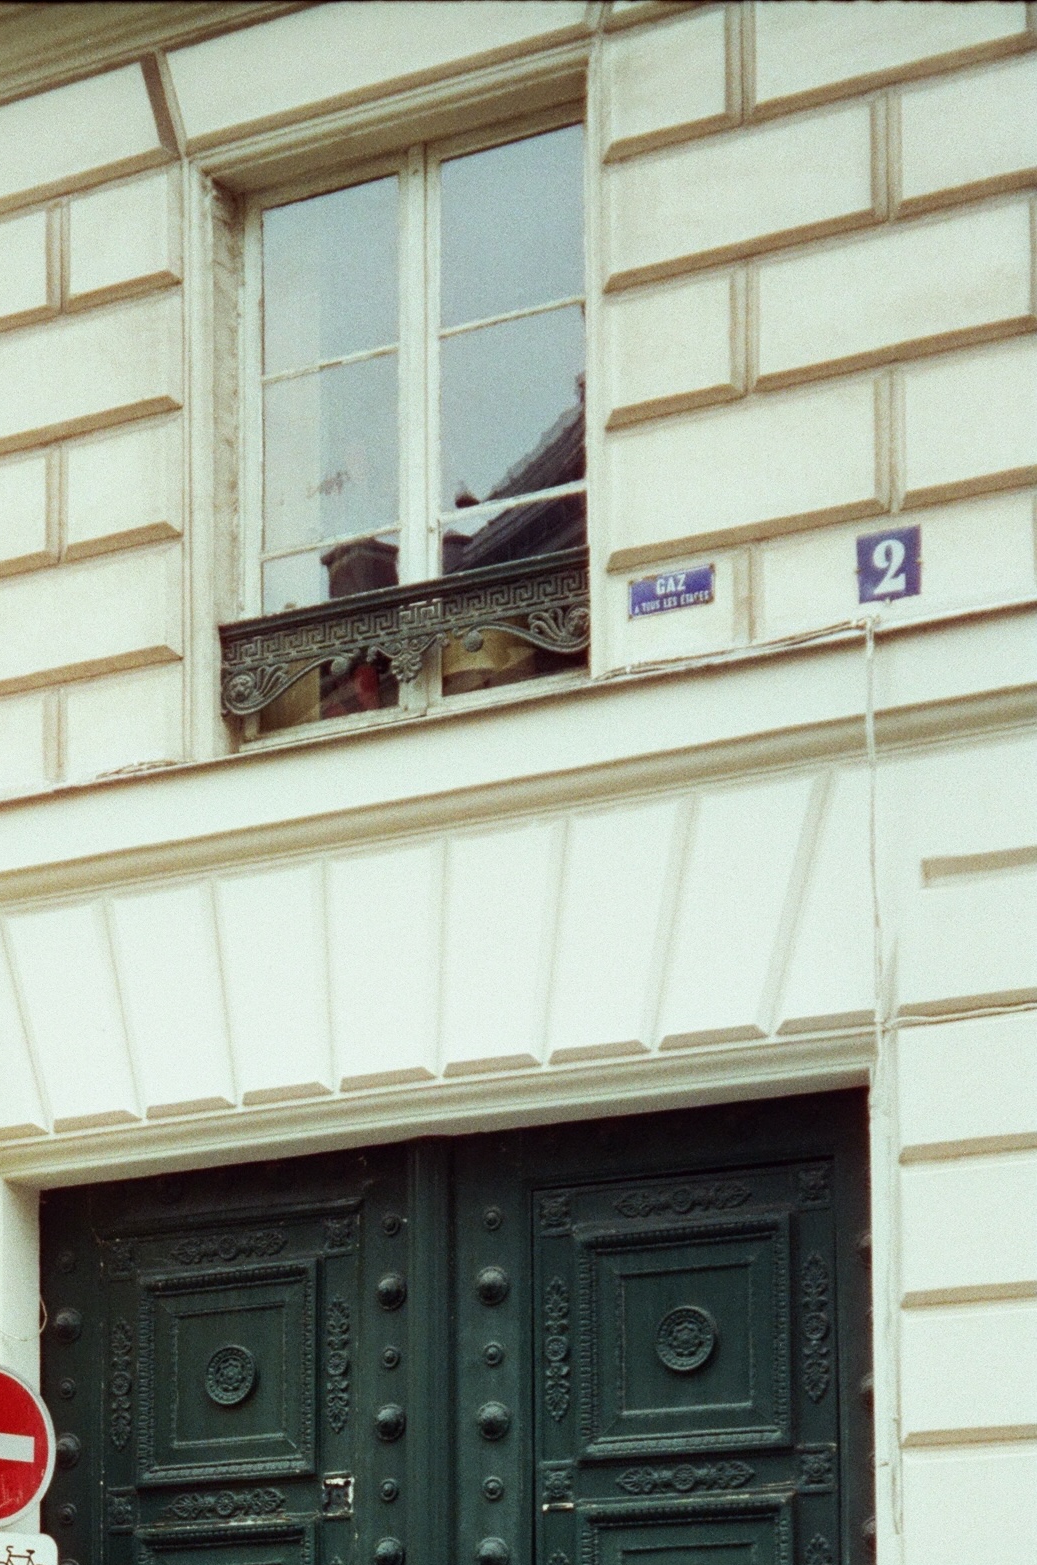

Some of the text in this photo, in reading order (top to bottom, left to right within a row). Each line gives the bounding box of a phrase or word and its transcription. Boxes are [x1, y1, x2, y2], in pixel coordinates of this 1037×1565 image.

[872, 538, 907, 595] 2
[656, 573, 686, 595] GAZ
[663, 596, 678, 609] LES
